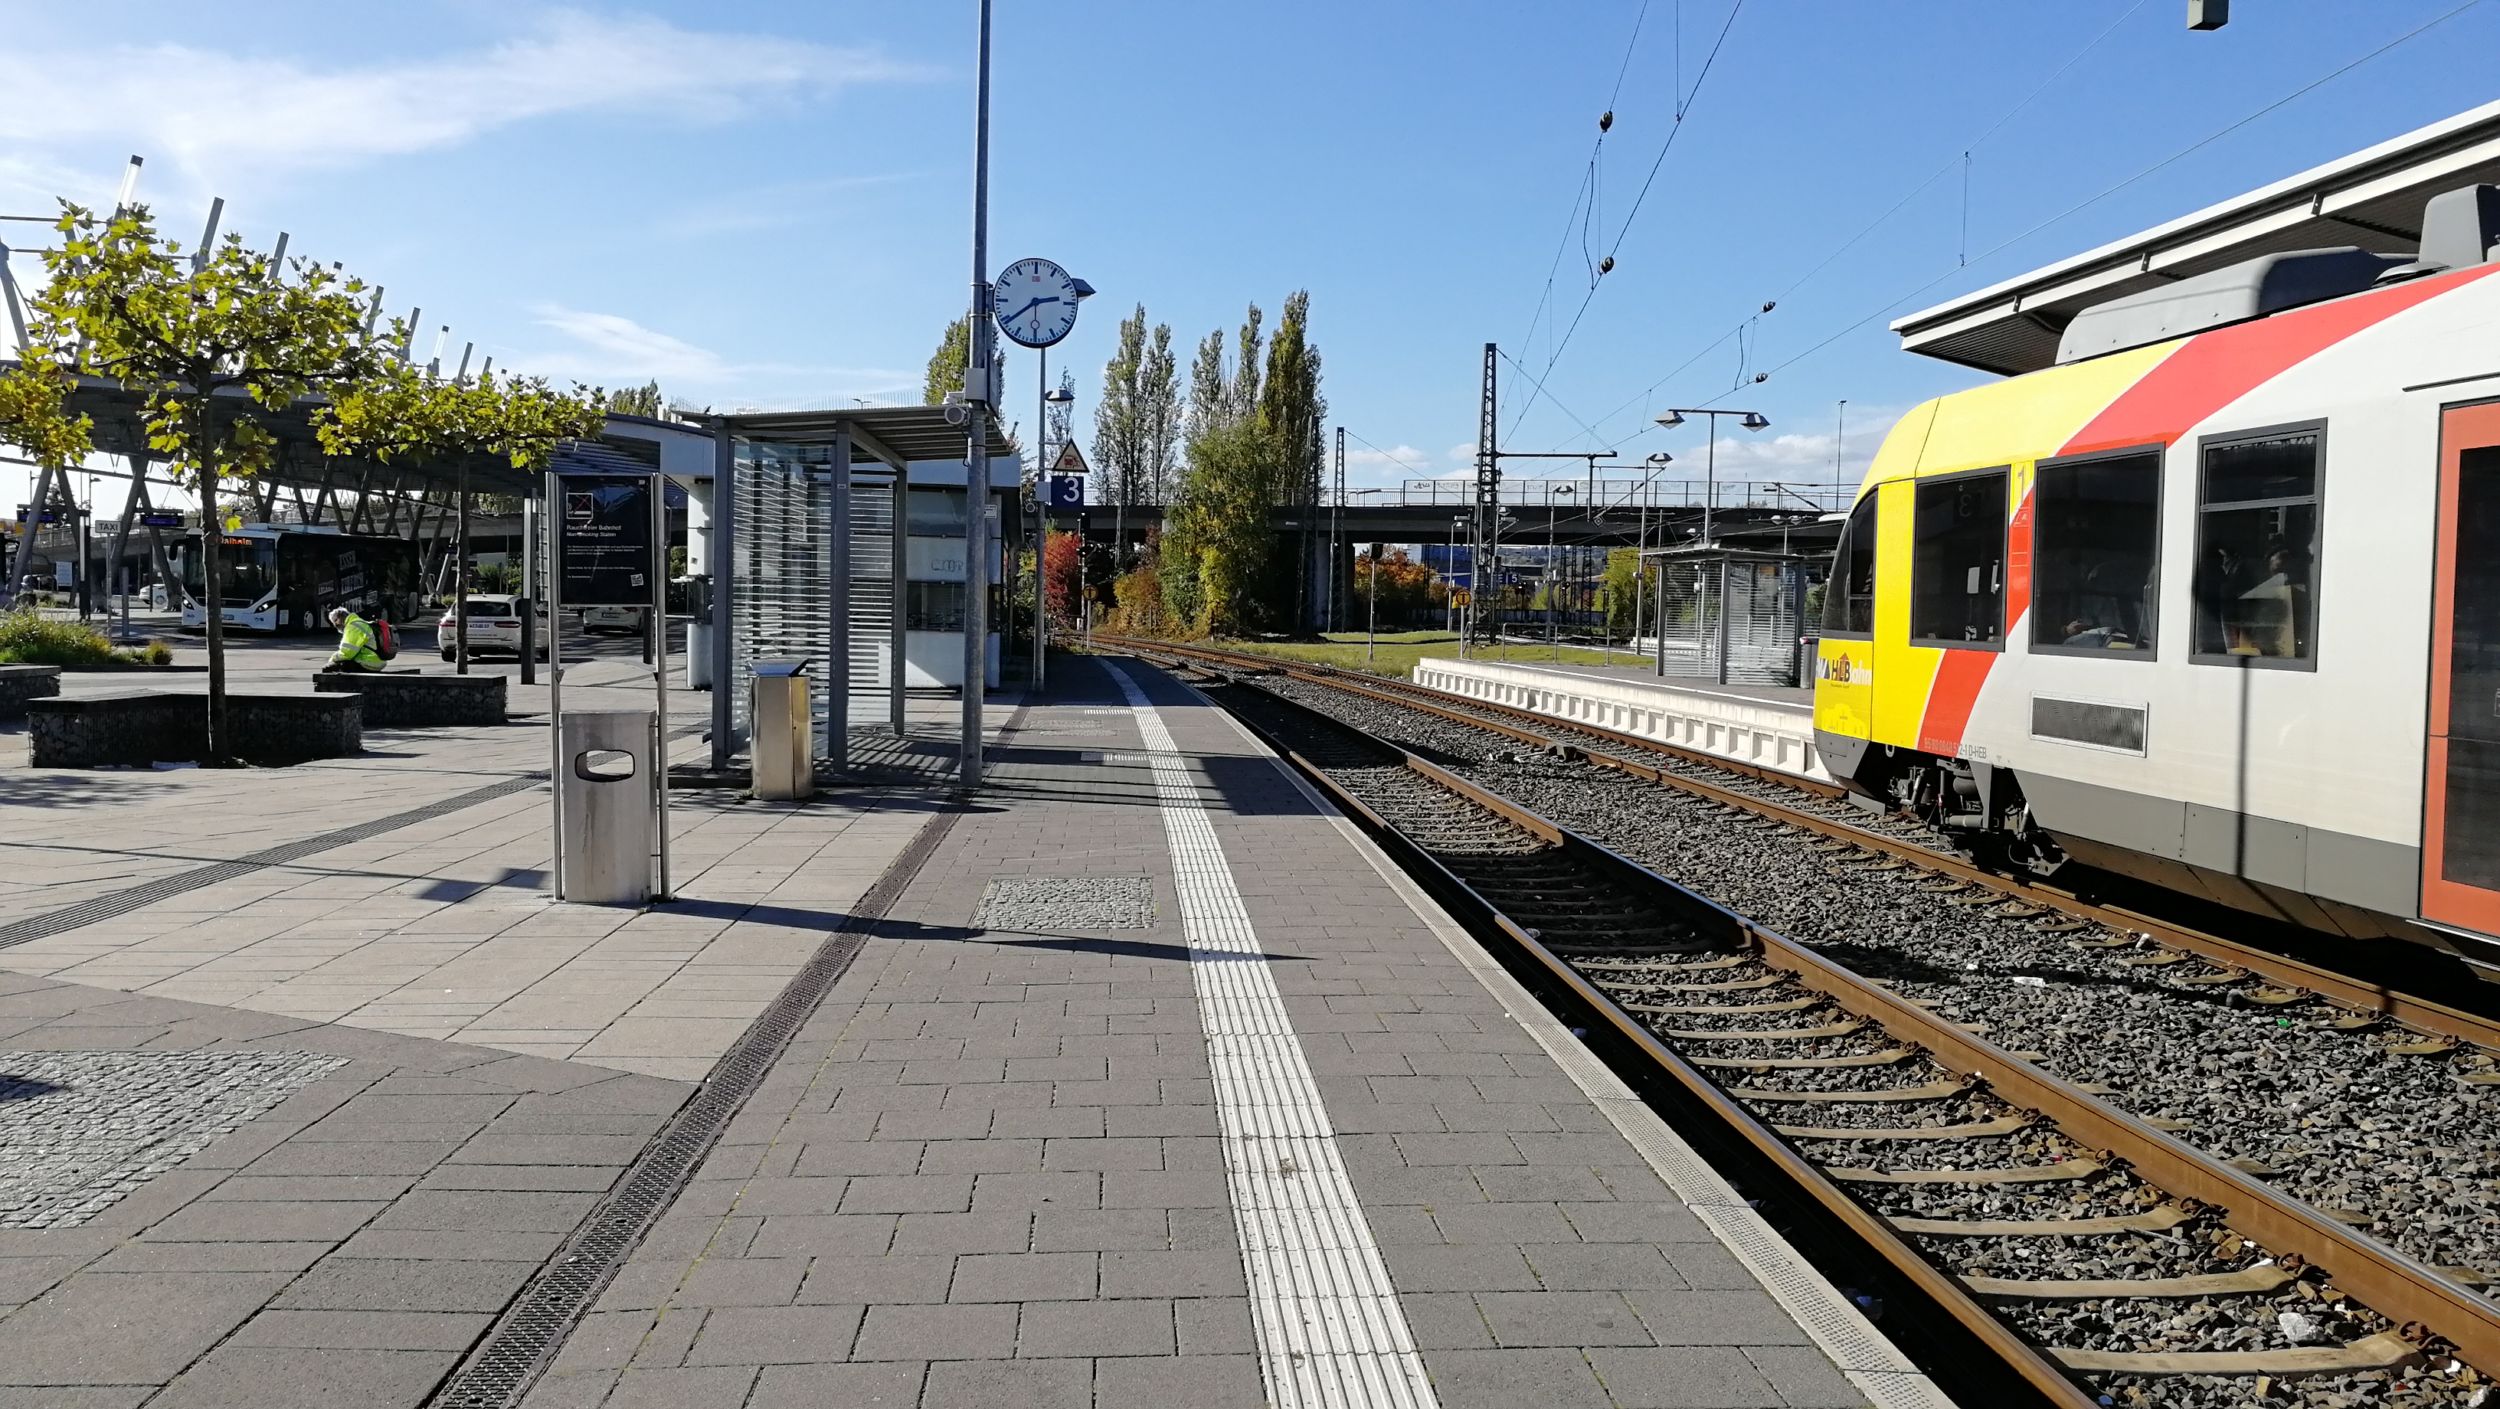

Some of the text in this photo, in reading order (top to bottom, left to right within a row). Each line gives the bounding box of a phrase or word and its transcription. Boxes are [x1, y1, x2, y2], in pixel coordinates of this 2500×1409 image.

[1063, 476, 1080, 503] 3
[99, 522, 119, 531] TAXI
[1511, 574, 1518, 582] 5
